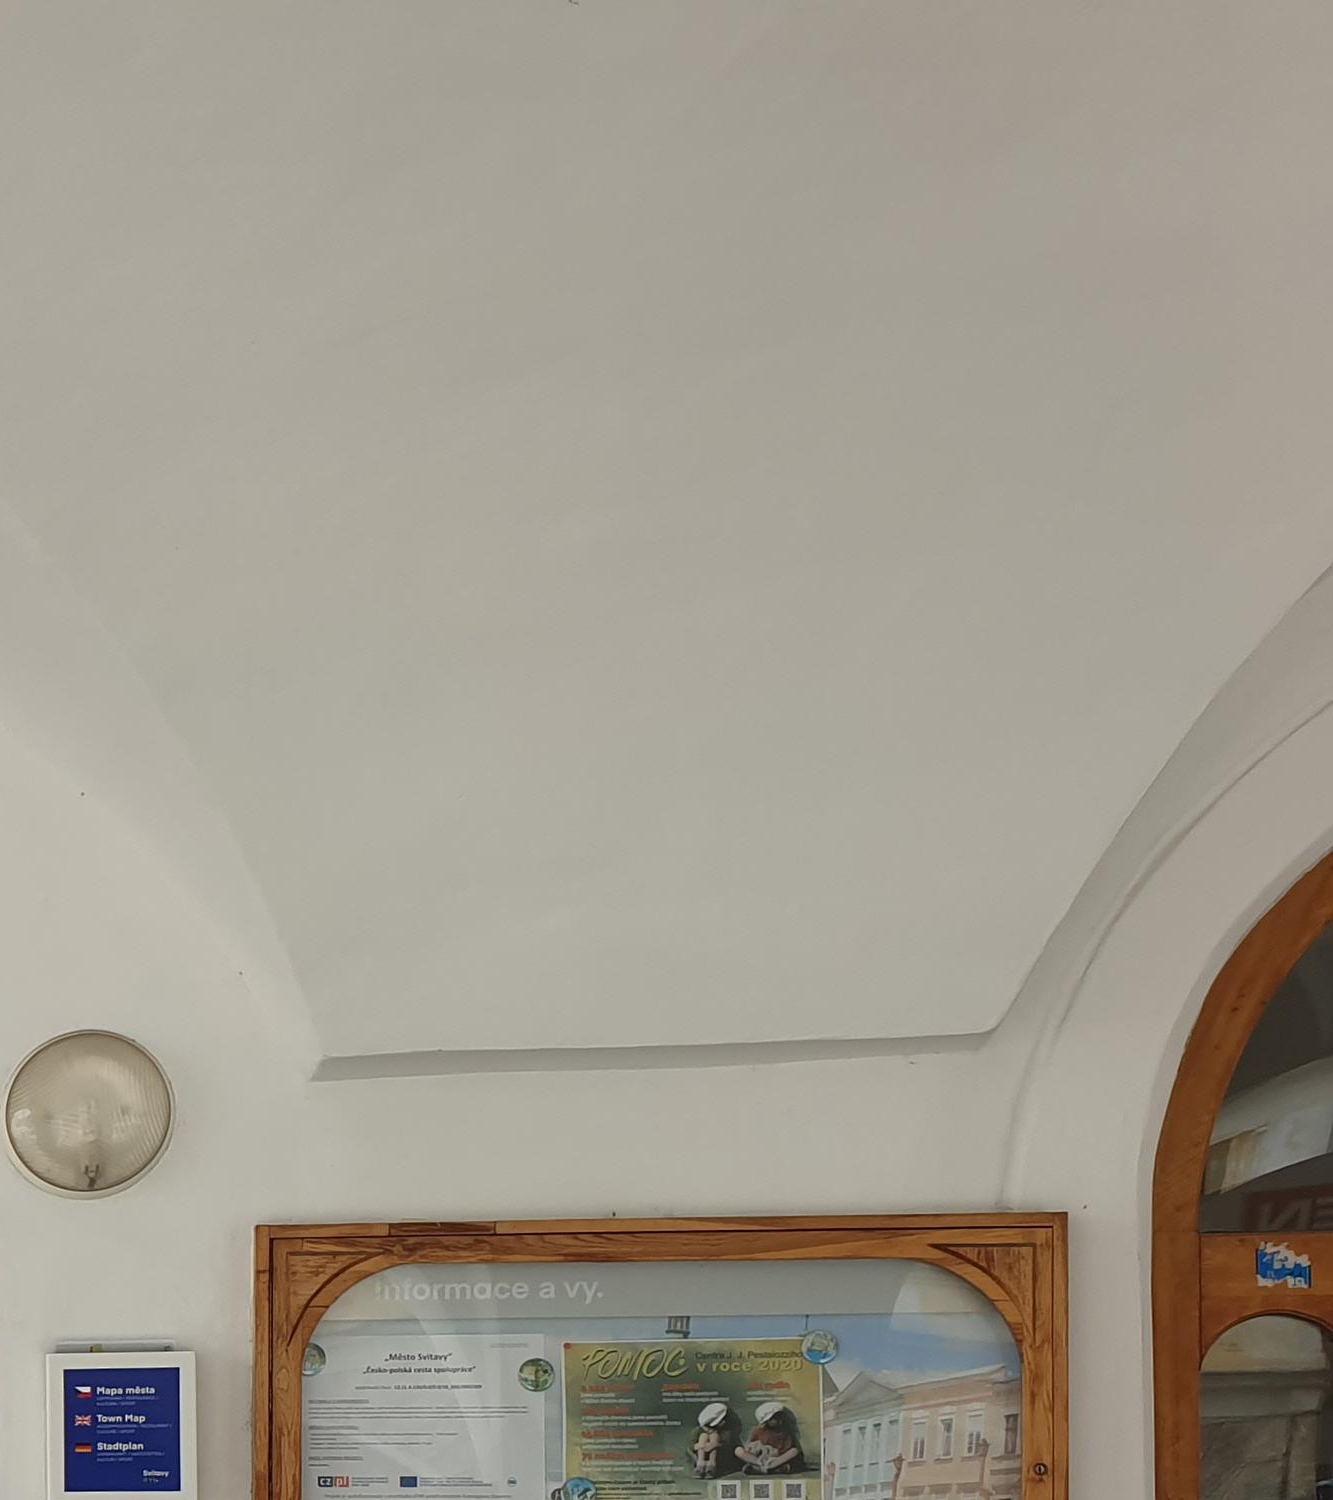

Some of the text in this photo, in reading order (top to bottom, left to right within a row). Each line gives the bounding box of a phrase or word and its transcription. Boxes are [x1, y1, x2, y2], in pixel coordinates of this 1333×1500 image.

[539, 1281, 556, 1299] a
[564, 1280, 605, 1304] vy.
[582, 1347, 687, 1382] POMOC
[696, 1358, 804, 1372] v roce 2020
[96, 1386, 156, 1396] Mapa města
[96, 1414, 146, 1424] Town Map
[96, 1441, 145, 1452] Stadtplan
